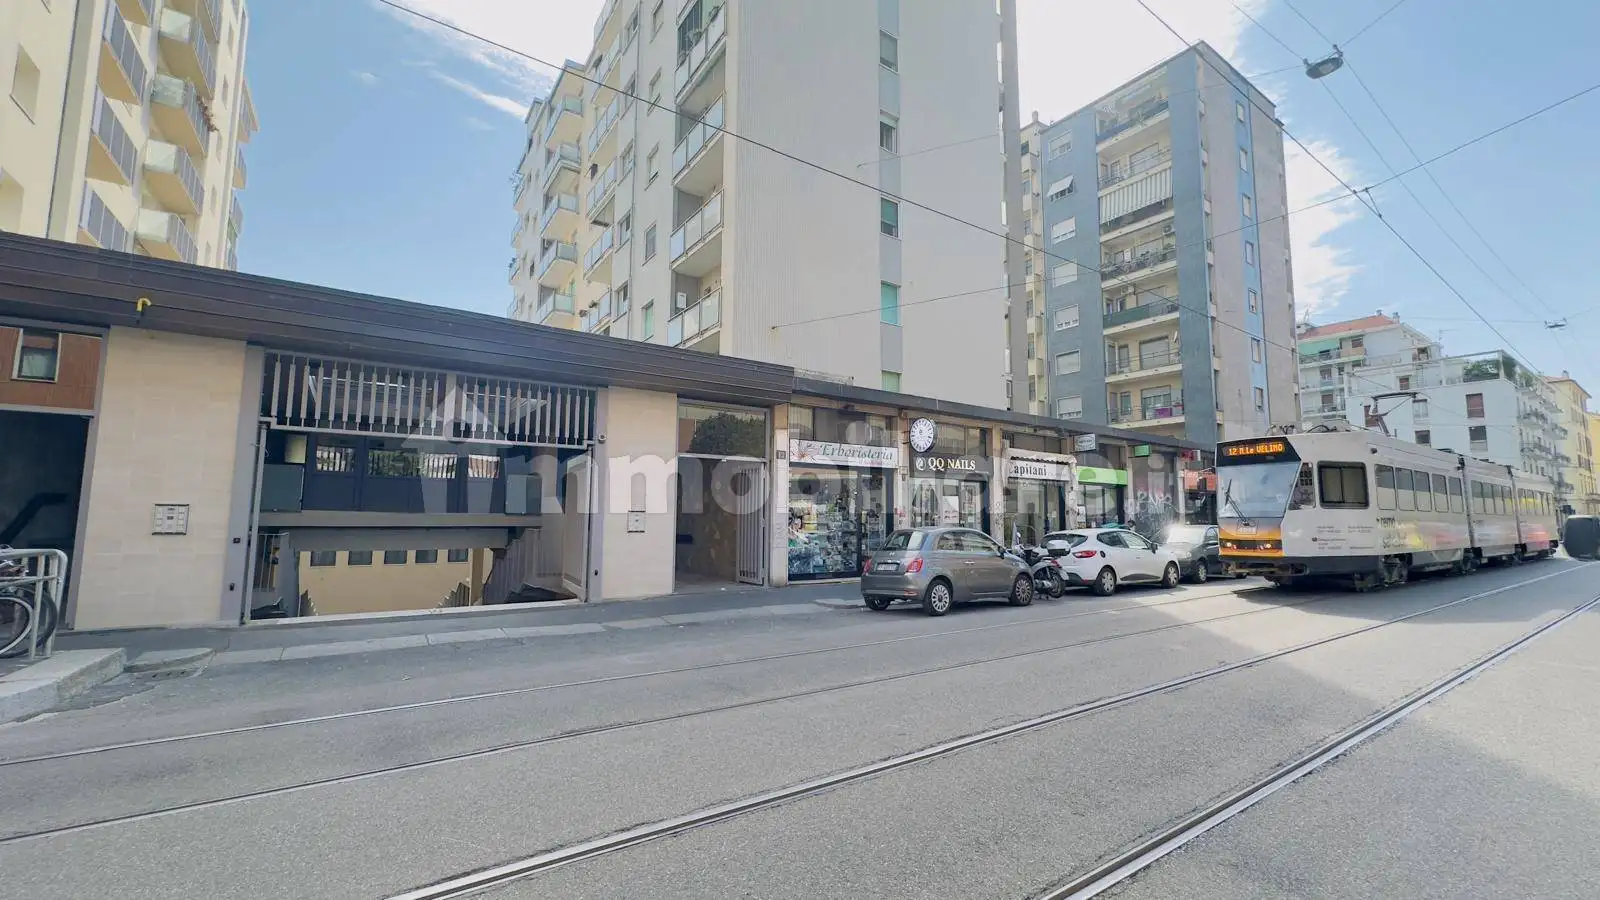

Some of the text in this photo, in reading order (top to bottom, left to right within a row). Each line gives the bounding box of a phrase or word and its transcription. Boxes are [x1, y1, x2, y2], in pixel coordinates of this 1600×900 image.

[820, 442, 893, 460] Erboristeria
[1228, 447, 1237, 456] 12
[928, 457, 976, 471] QQ NAILS
